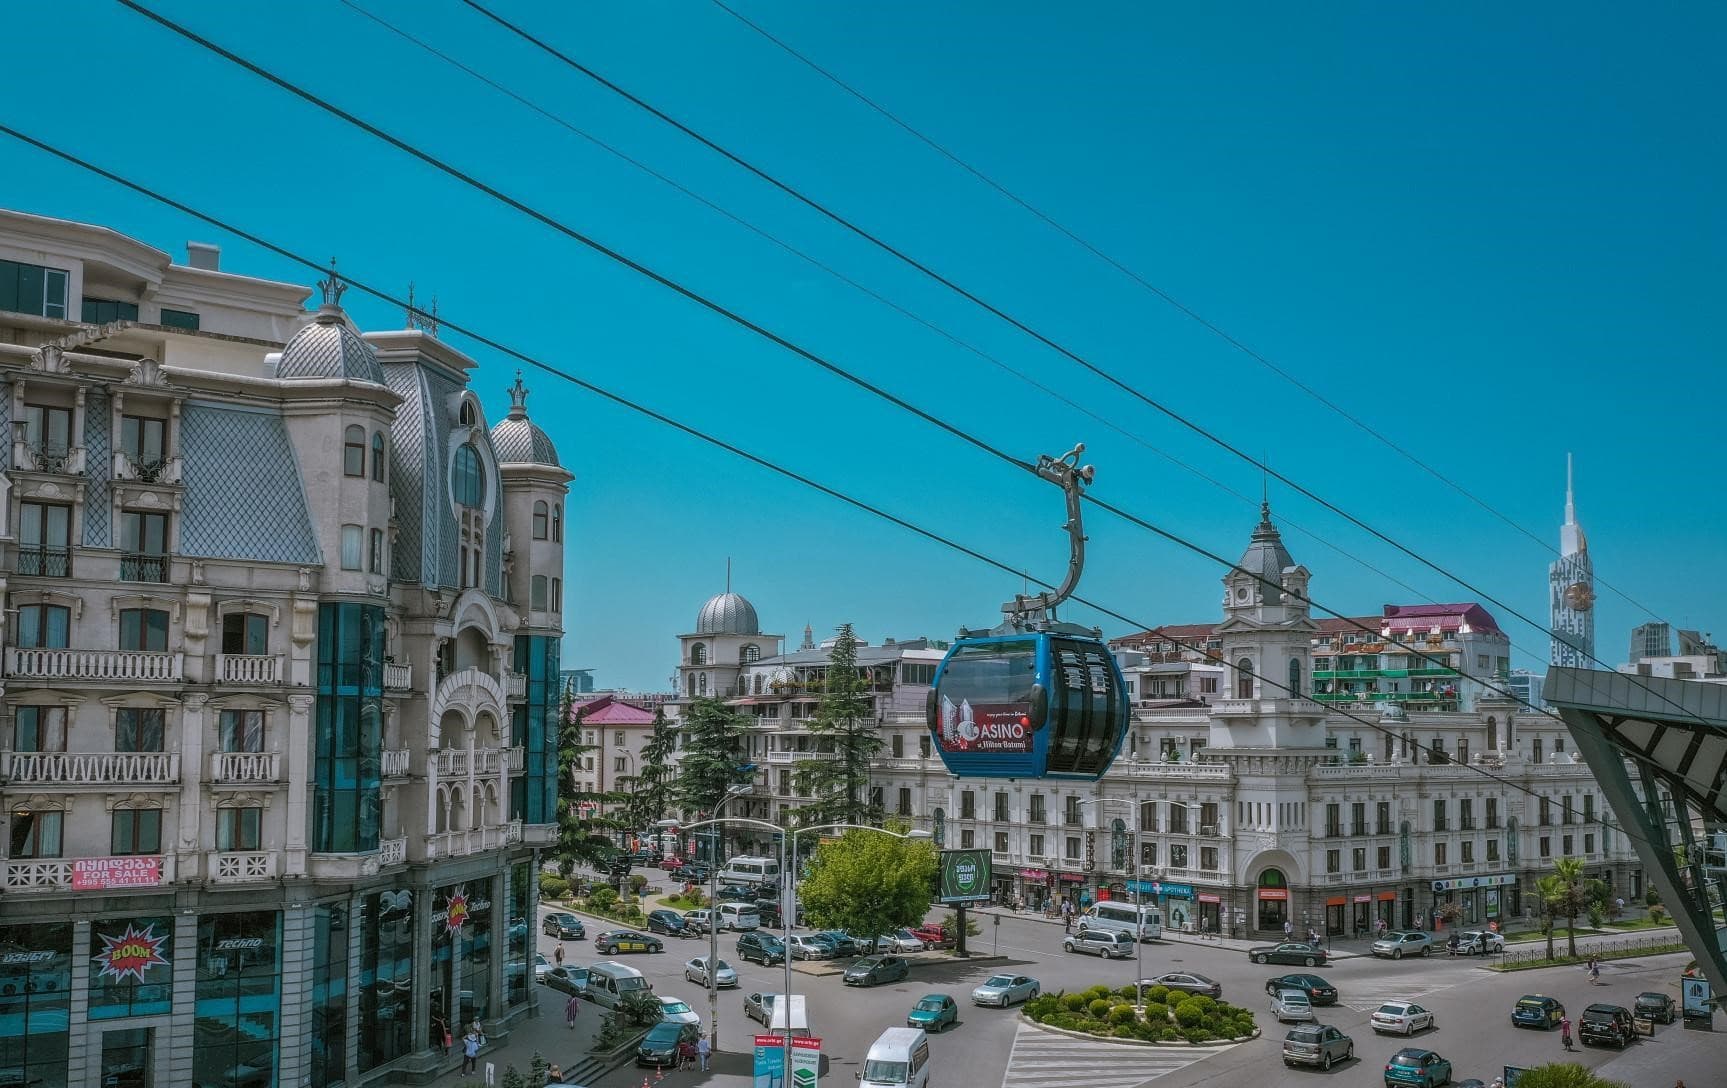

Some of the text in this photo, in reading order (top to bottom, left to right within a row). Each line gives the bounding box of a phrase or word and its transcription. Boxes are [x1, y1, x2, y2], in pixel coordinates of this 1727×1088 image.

[75, 858, 156, 872] იყიდება
[83, 869, 148, 879] FOR SALE
[216, 938, 264, 950] Techno
[112, 944, 151, 961] BOOM
